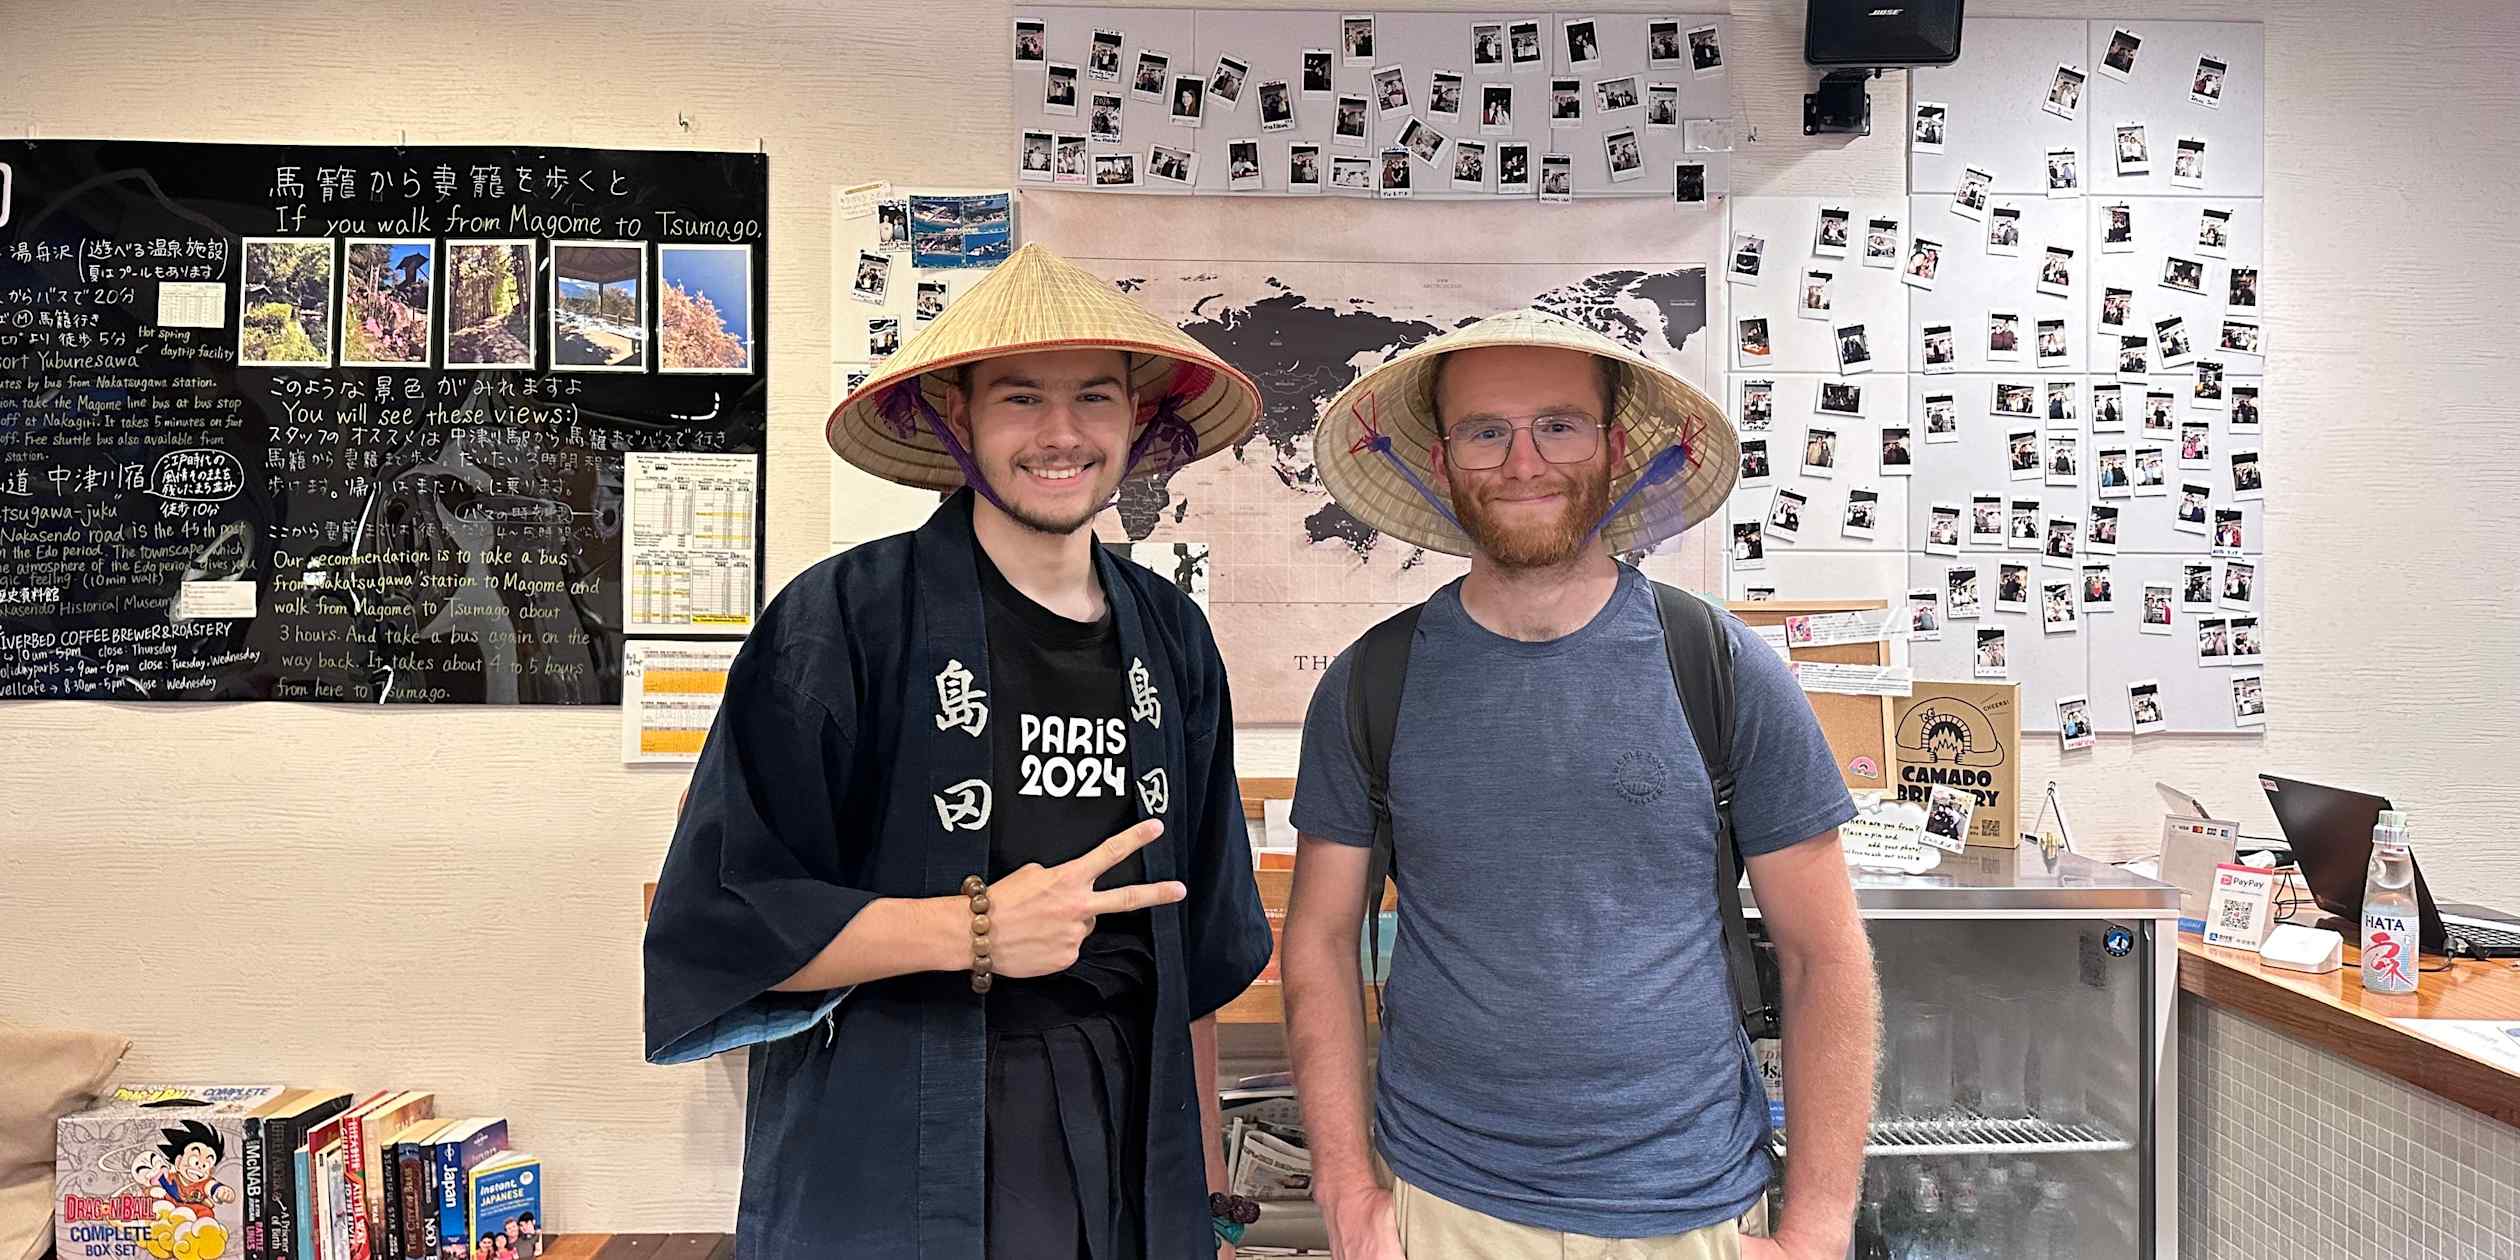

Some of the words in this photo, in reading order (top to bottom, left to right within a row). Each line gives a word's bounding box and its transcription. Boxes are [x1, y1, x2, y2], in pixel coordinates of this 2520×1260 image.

[275, 204, 306, 232] If
[324, 219, 366, 236] you
[378, 206, 431, 235] walk
[445, 204, 500, 233] from
[509, 203, 602, 239] Magome
[616, 217, 641, 236] to
[655, 211, 762, 242] Tsumago,
[139, 326, 155, 338] Hot
[159, 329, 190, 343] spring
[37, 350, 139, 371] Yubunesawa
[161, 346, 195, 359] daytrip
[197, 345, 234, 360] facility
[27, 376, 39, 392] by
[44, 376, 62, 388] bus
[67, 376, 90, 388] from
[96, 376, 167, 391] Nakatsugawa
[172, 377, 217, 388] station.
[23, 396, 49, 408] take
[55, 396, 72, 407] the
[78, 395, 122, 416] Magome
[127, 396, 146, 408] line
[153, 396, 170, 408] bus
[176, 398, 188, 408] at
[194, 396, 212, 408] bus
[217, 398, 242, 415] stop
[281, 400, 323, 424] You
[337, 402, 367, 425] will
[378, 407, 413, 425] see
[426, 402, 485, 426] these
[25, 416, 37, 426] at
[105, 415, 116, 427] It
[121, 416, 149, 428] takes
[154, 416, 162, 427] 5
[164, 417, 206, 428] minutes
[209, 419, 222, 427] on
[24, 433, 48, 445] Free
[52, 433, 92, 445] shuttle
[97, 433, 114, 445] bus
[117, 433, 140, 445] also
[143, 432, 193, 445] available
[200, 431, 225, 445] from
[0, 502, 118, 528] tsugawa-juku
[0, 527, 80, 544] Nakasendo
[89, 522, 125, 542] road
[132, 521, 148, 538] is
[154, 523, 175, 539] the
[14, 544, 31, 558] the
[36, 544, 58, 559] Edo
[113, 544, 136, 559] The
[140, 544, 204, 563] townscape
[274, 550, 304, 569] Our
[438, 549, 450, 562] is
[457, 549, 471, 563] to
[480, 546, 512, 565] take
[521, 551, 533, 564] a
[539, 548, 568, 566] bus
[17, 560, 85, 576] atmosphere
[91, 558, 104, 572] of
[112, 559, 130, 572] the
[135, 559, 156, 573] Edo
[485, 574, 499, 588] to
[503, 572, 565, 597] Magome
[570, 577, 600, 595] and
[60, 596, 118, 616] Historical
[274, 596, 310, 615] walk
[316, 596, 348, 614] from
[354, 597, 412, 622] Magome
[421, 600, 437, 616] to
[443, 597, 511, 621] Tsumago
[519, 602, 561, 619] about
[0, 633, 55, 651] IVERBED
[61, 628, 110, 646] COFFEE
[280, 624, 290, 641] 3
[346, 625, 377, 643] And
[385, 624, 420, 644] take
[431, 631, 442, 643] a
[451, 624, 479, 645] bus
[488, 631, 534, 649] again
[542, 631, 559, 644] on
[568, 627, 591, 645] the
[132, 643, 177, 660] Thursday
[281, 655, 312, 672] way
[367, 650, 383, 668] It
[392, 651, 434, 672] takes
[443, 653, 483, 672] about
[489, 654, 501, 673] 4
[511, 662, 523, 674] to
[529, 657, 540, 674] 5
[544, 655, 584, 675] hours
[1294, 655, 1337, 671] TH
[167, 677, 217, 693] Wednesday
[277, 676, 308, 698] from
[315, 676, 344, 698] here
[353, 684, 368, 698] to
[1018, 754, 1126, 798] 2024
[1902, 766, 1992, 787] CAMADO
[2233, 877, 2264, 889] PayPay
[2365, 914, 2405, 932] HATA
[245, 1144, 262, 1196] McNAB
[441, 1164, 458, 1208] Japan
[480, 1179, 517, 1196] Instant
[480, 1188, 524, 1207] JAPANESE
[70, 1226, 151, 1242] COMPLETE
[85, 1244, 111, 1257] BOX
[114, 1244, 138, 1257] SET
